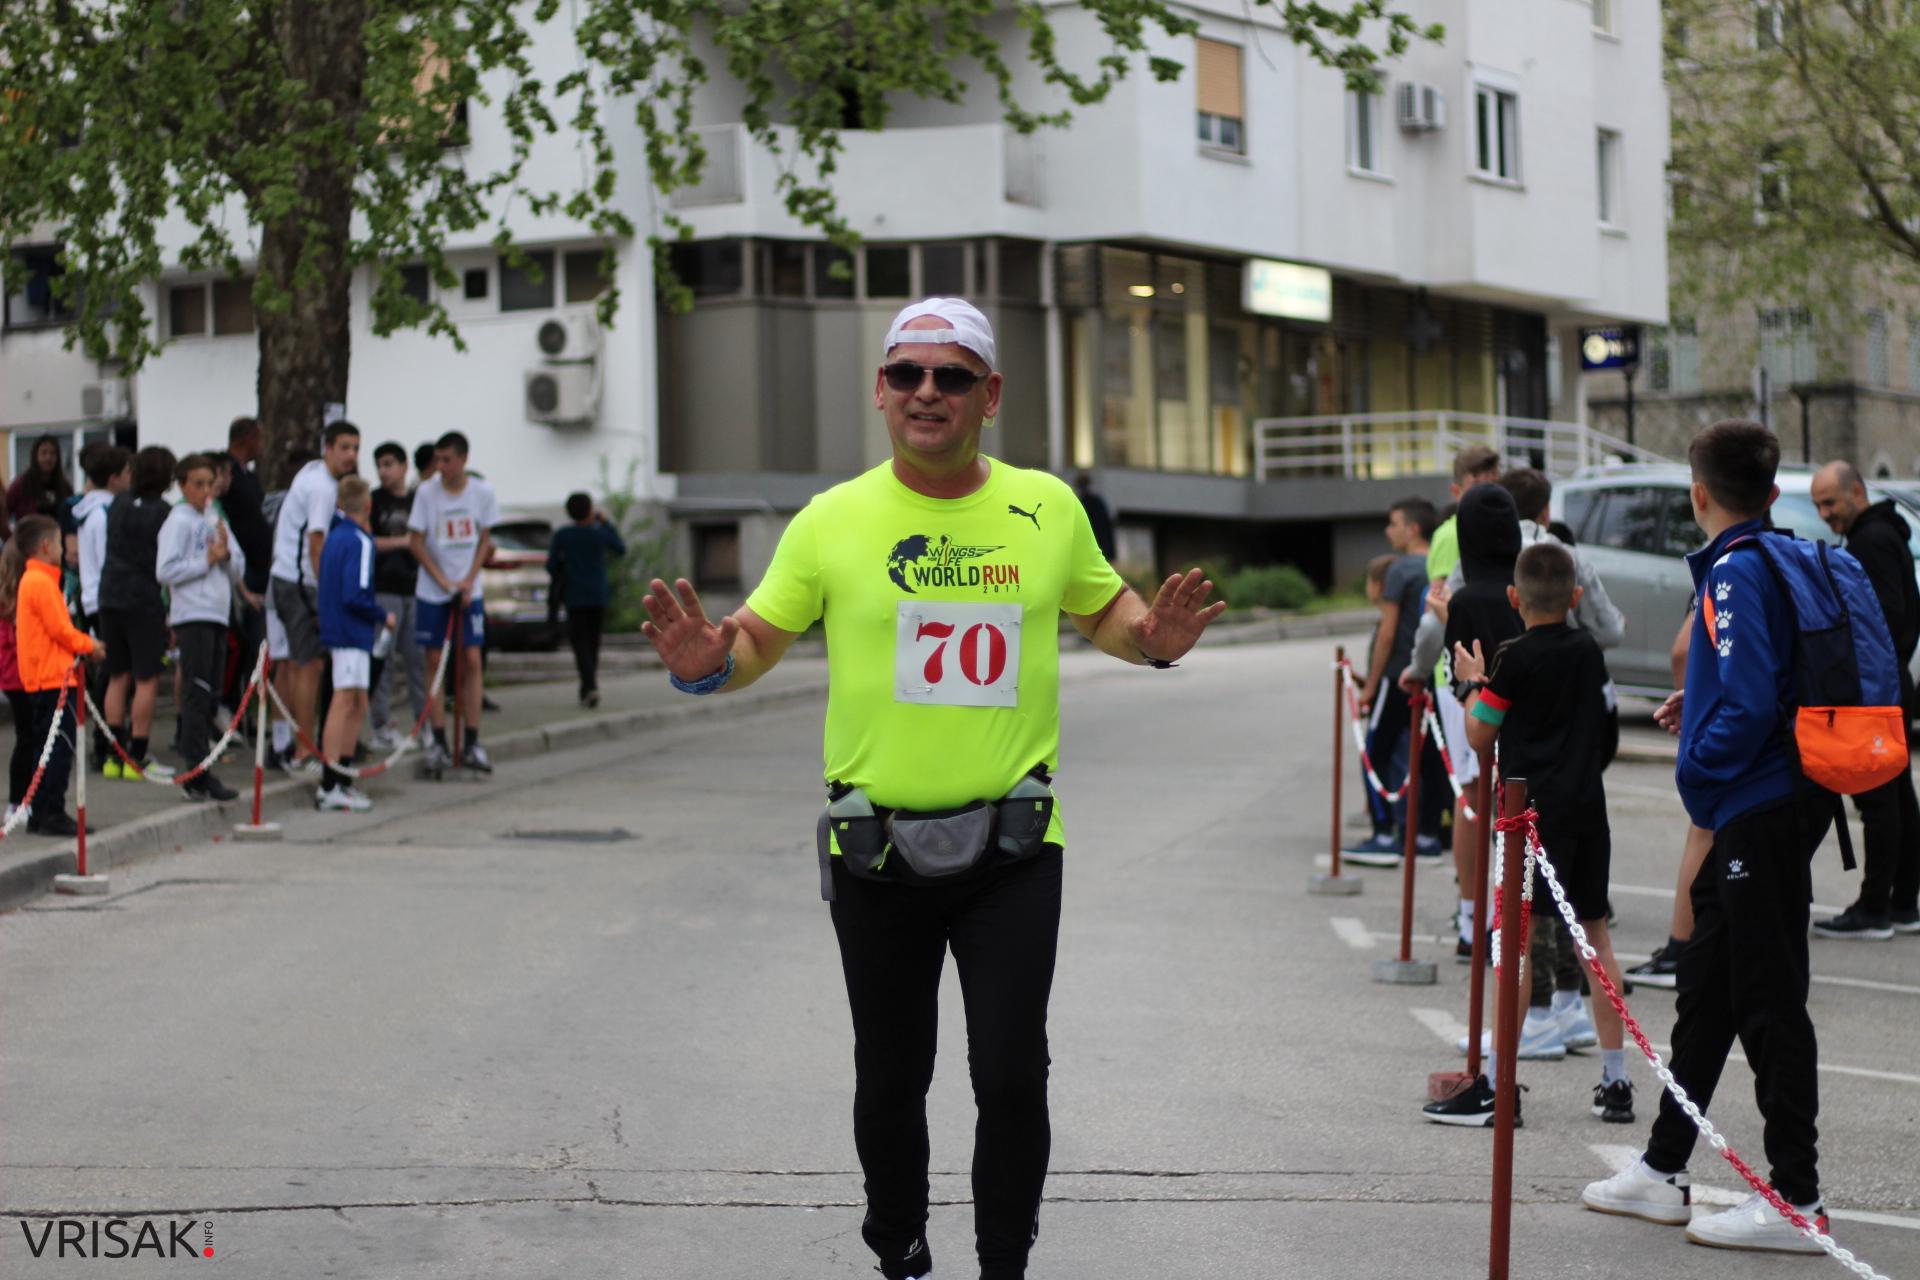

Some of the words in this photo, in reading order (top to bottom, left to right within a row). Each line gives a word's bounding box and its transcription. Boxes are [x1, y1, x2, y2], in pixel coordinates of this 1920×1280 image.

[929, 546, 976, 557] WINGS
[937, 557, 963, 567] LIFE
[913, 566, 980, 587] WORLD
[982, 565, 1020, 585] RUN
[983, 585, 1020, 594] 2017
[916, 621, 1007, 686] 70
